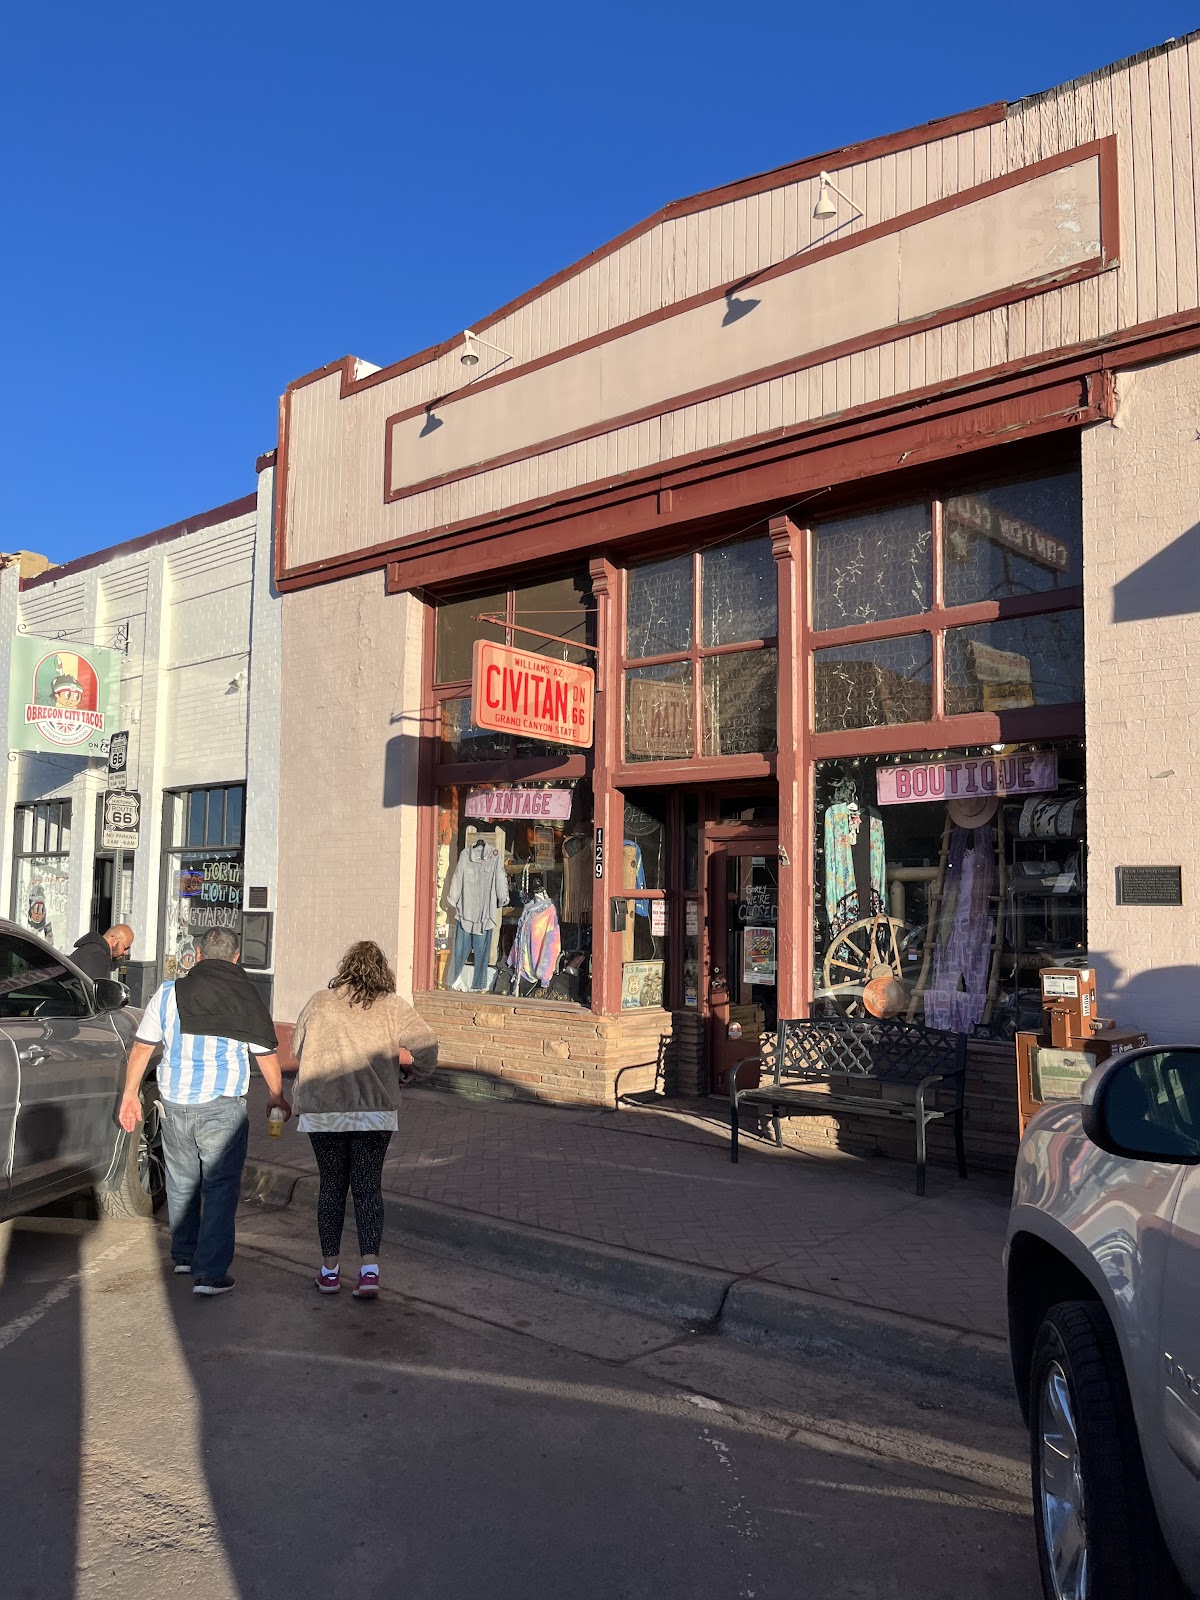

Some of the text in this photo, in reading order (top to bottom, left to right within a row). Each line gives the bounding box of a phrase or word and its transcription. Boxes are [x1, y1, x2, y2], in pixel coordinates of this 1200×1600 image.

[515, 658, 563, 677] WILLIAMS AZ
[486, 664, 568, 724] CIVITAN
[573, 686, 585, 703] ON
[27, 705, 103, 730] OBREGON CITY TACOS
[572, 707, 585, 725] 66
[42, 725, 62, 741] AUTHENTIC
[80, 729, 89, 739] FOOD
[495, 714, 577, 738] GRAND CANYON STATE
[112, 753, 122, 764] 66
[895, 757, 1035, 798] BOUTIQUE
[485, 793, 552, 814] VINTAGE
[113, 812, 132, 823] 66
[595, 830, 603, 878] 129
[201, 883, 227, 902] HOT
[745, 894, 770, 905] WE'RE
[738, 904, 778, 920] CLOSED
